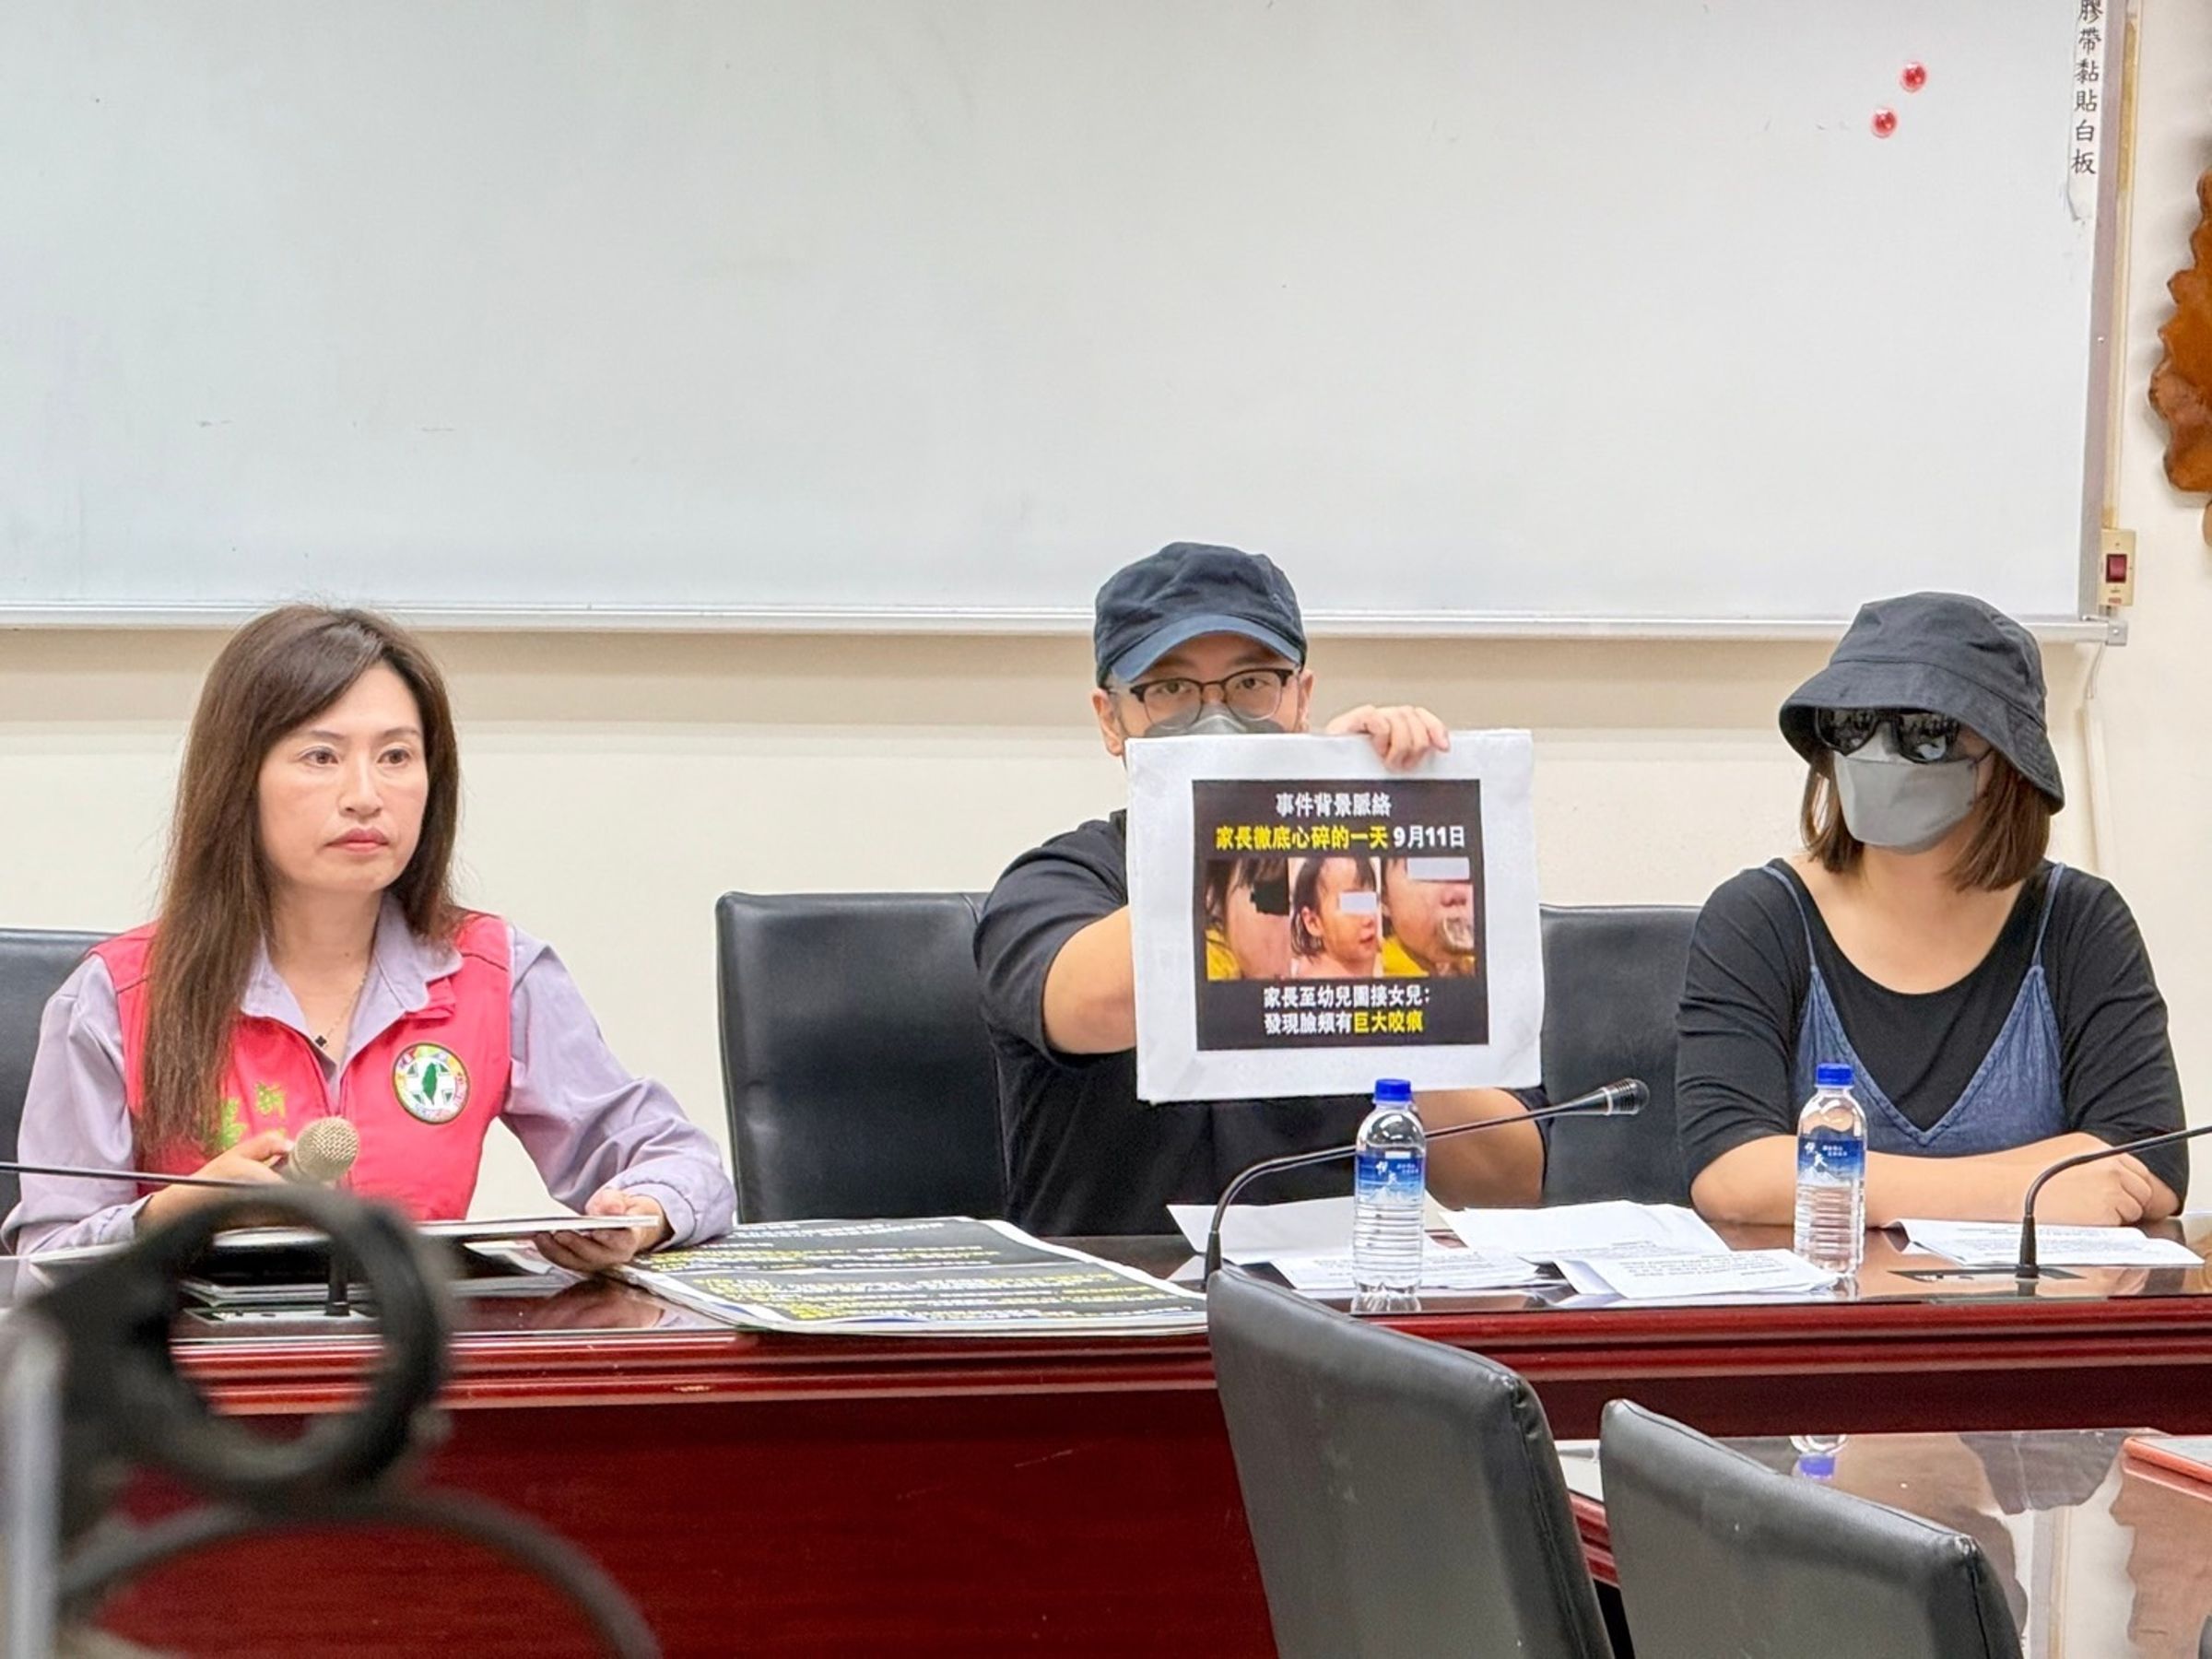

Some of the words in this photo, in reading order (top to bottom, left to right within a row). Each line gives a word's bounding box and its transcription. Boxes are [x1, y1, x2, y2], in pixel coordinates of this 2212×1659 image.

[1276, 793, 1392, 817] 事件背景脈絡
[1216, 826, 1388, 851] 家長徹底心碎的一天
[1393, 825, 1465, 849] 9月11日
[1265, 1010, 1424, 1035] 發現臉頰有巨大咬痕
